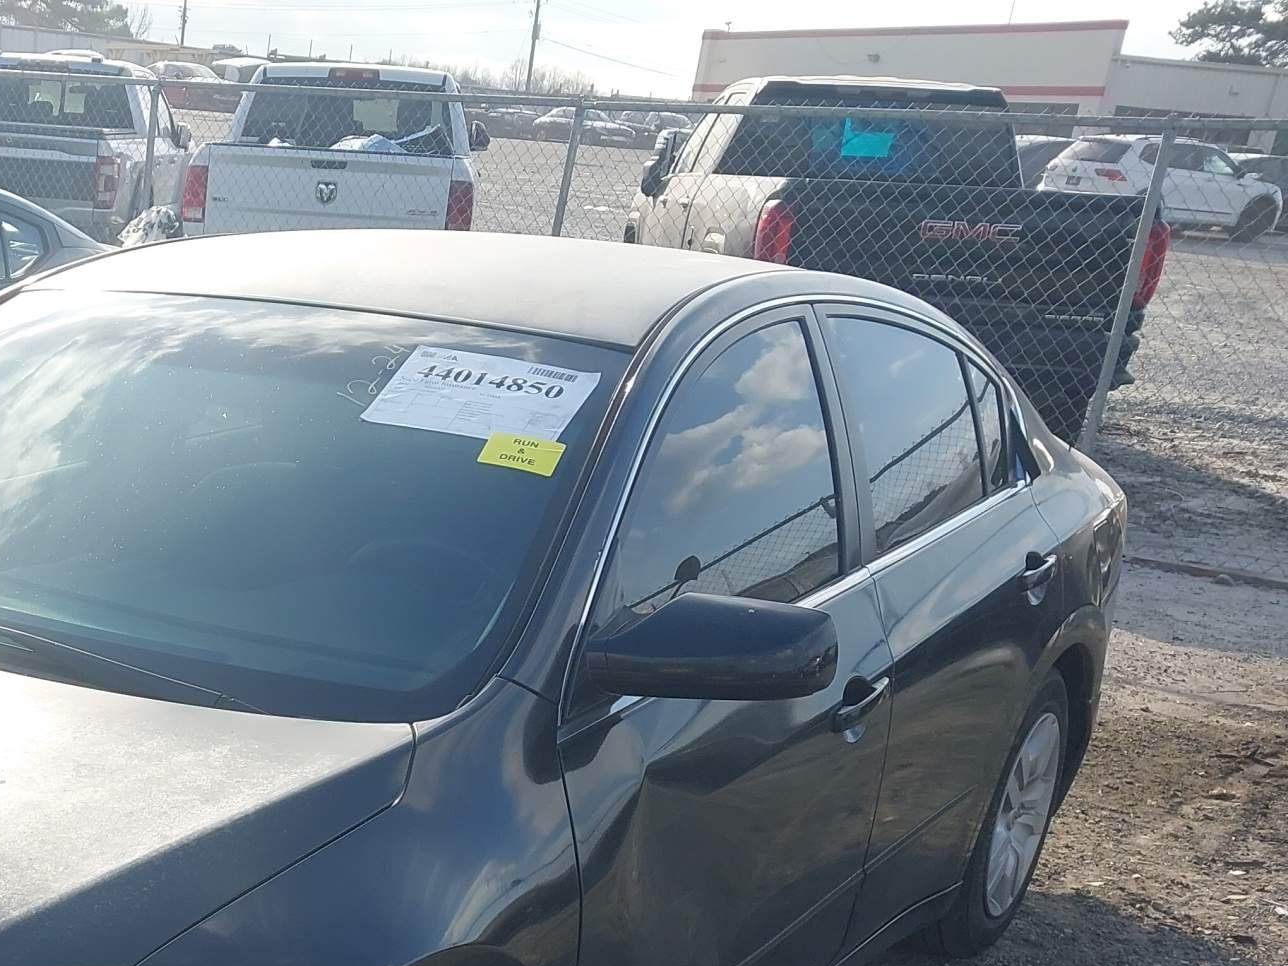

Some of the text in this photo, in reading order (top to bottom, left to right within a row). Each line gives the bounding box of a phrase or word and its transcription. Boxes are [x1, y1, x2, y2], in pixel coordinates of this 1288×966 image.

[920, 219, 1022, 242] GMC
[336, 344, 410, 407] 12-24
[416, 364, 565, 400] 44014850
[513, 438, 540, 449] RUN
[498, 453, 537, 466] DRIVE
